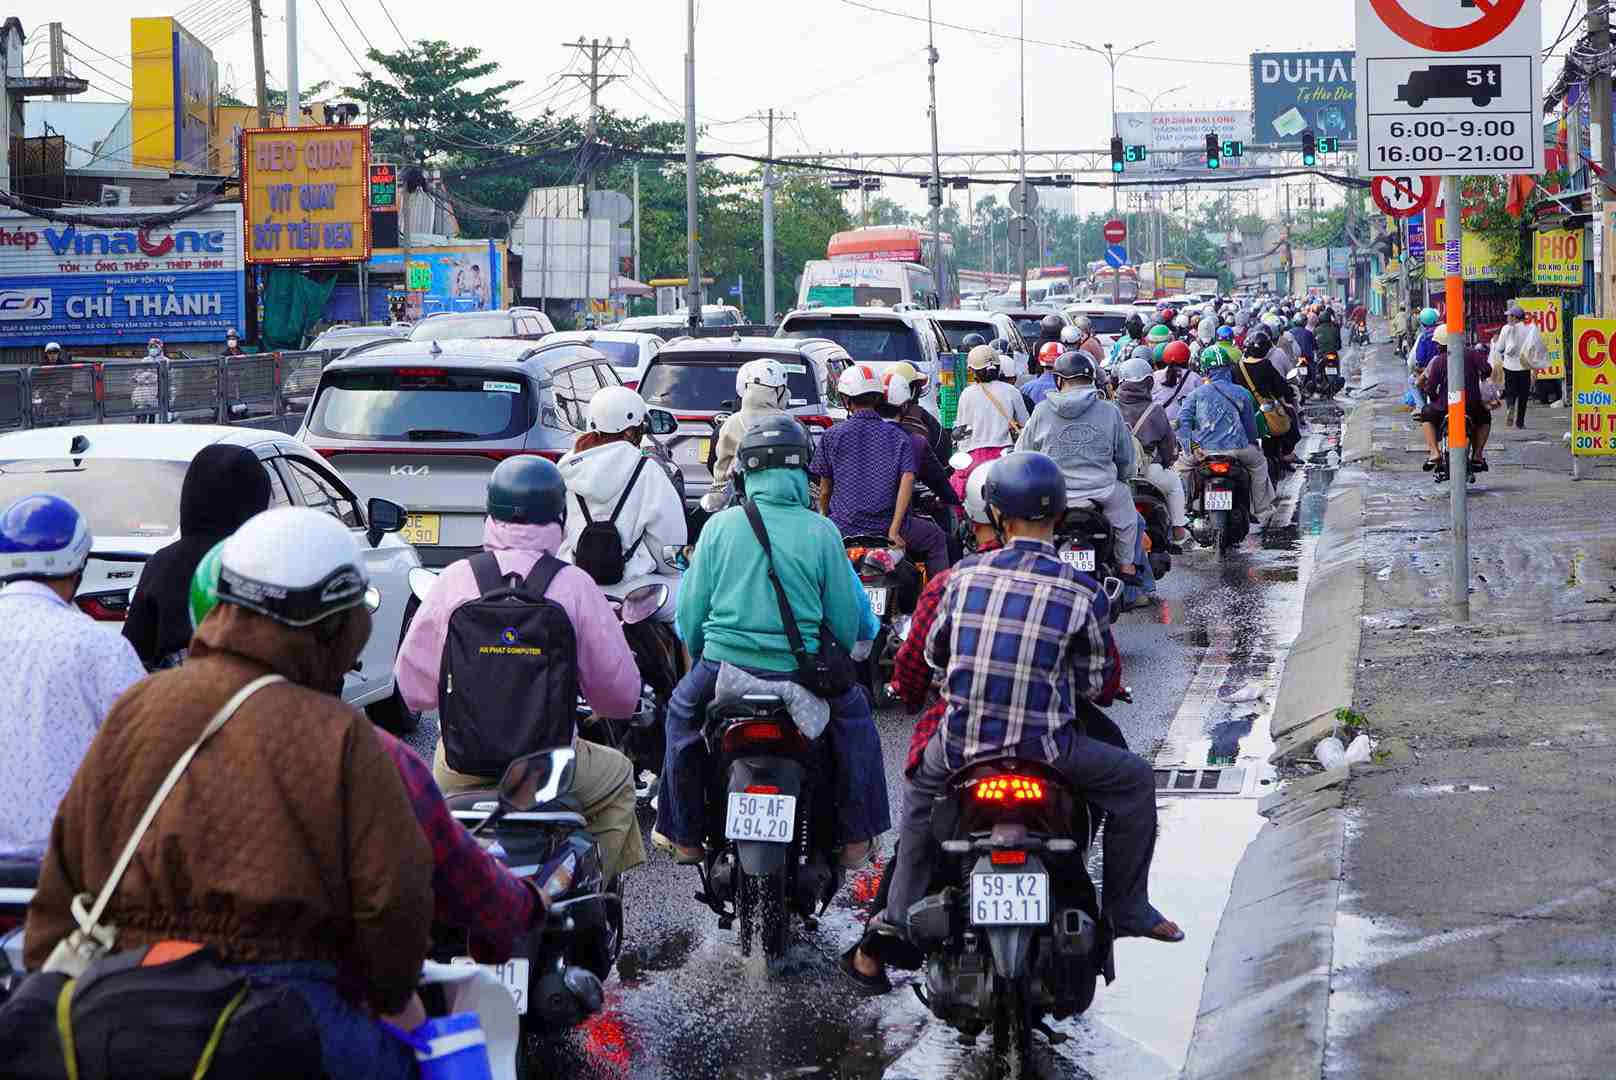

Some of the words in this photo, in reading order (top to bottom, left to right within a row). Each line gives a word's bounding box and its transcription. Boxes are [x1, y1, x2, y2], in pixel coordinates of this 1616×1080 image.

[1390, 120, 1515, 138] 6:00-9:00
[304, 139, 353, 171] QUAY
[1377, 145, 1524, 162] 16:00-21:00
[0, 226, 38, 250] hép
[66, 286, 114, 319] CHÍ
[124, 285, 222, 318] THÀNH
[390, 464, 430, 476] KIA
[739, 797, 784, 817] 50-AF
[732, 817, 788, 838] 494.20
[983, 875, 1036, 897] 59-K2
[976, 899, 1041, 921] 613.11
